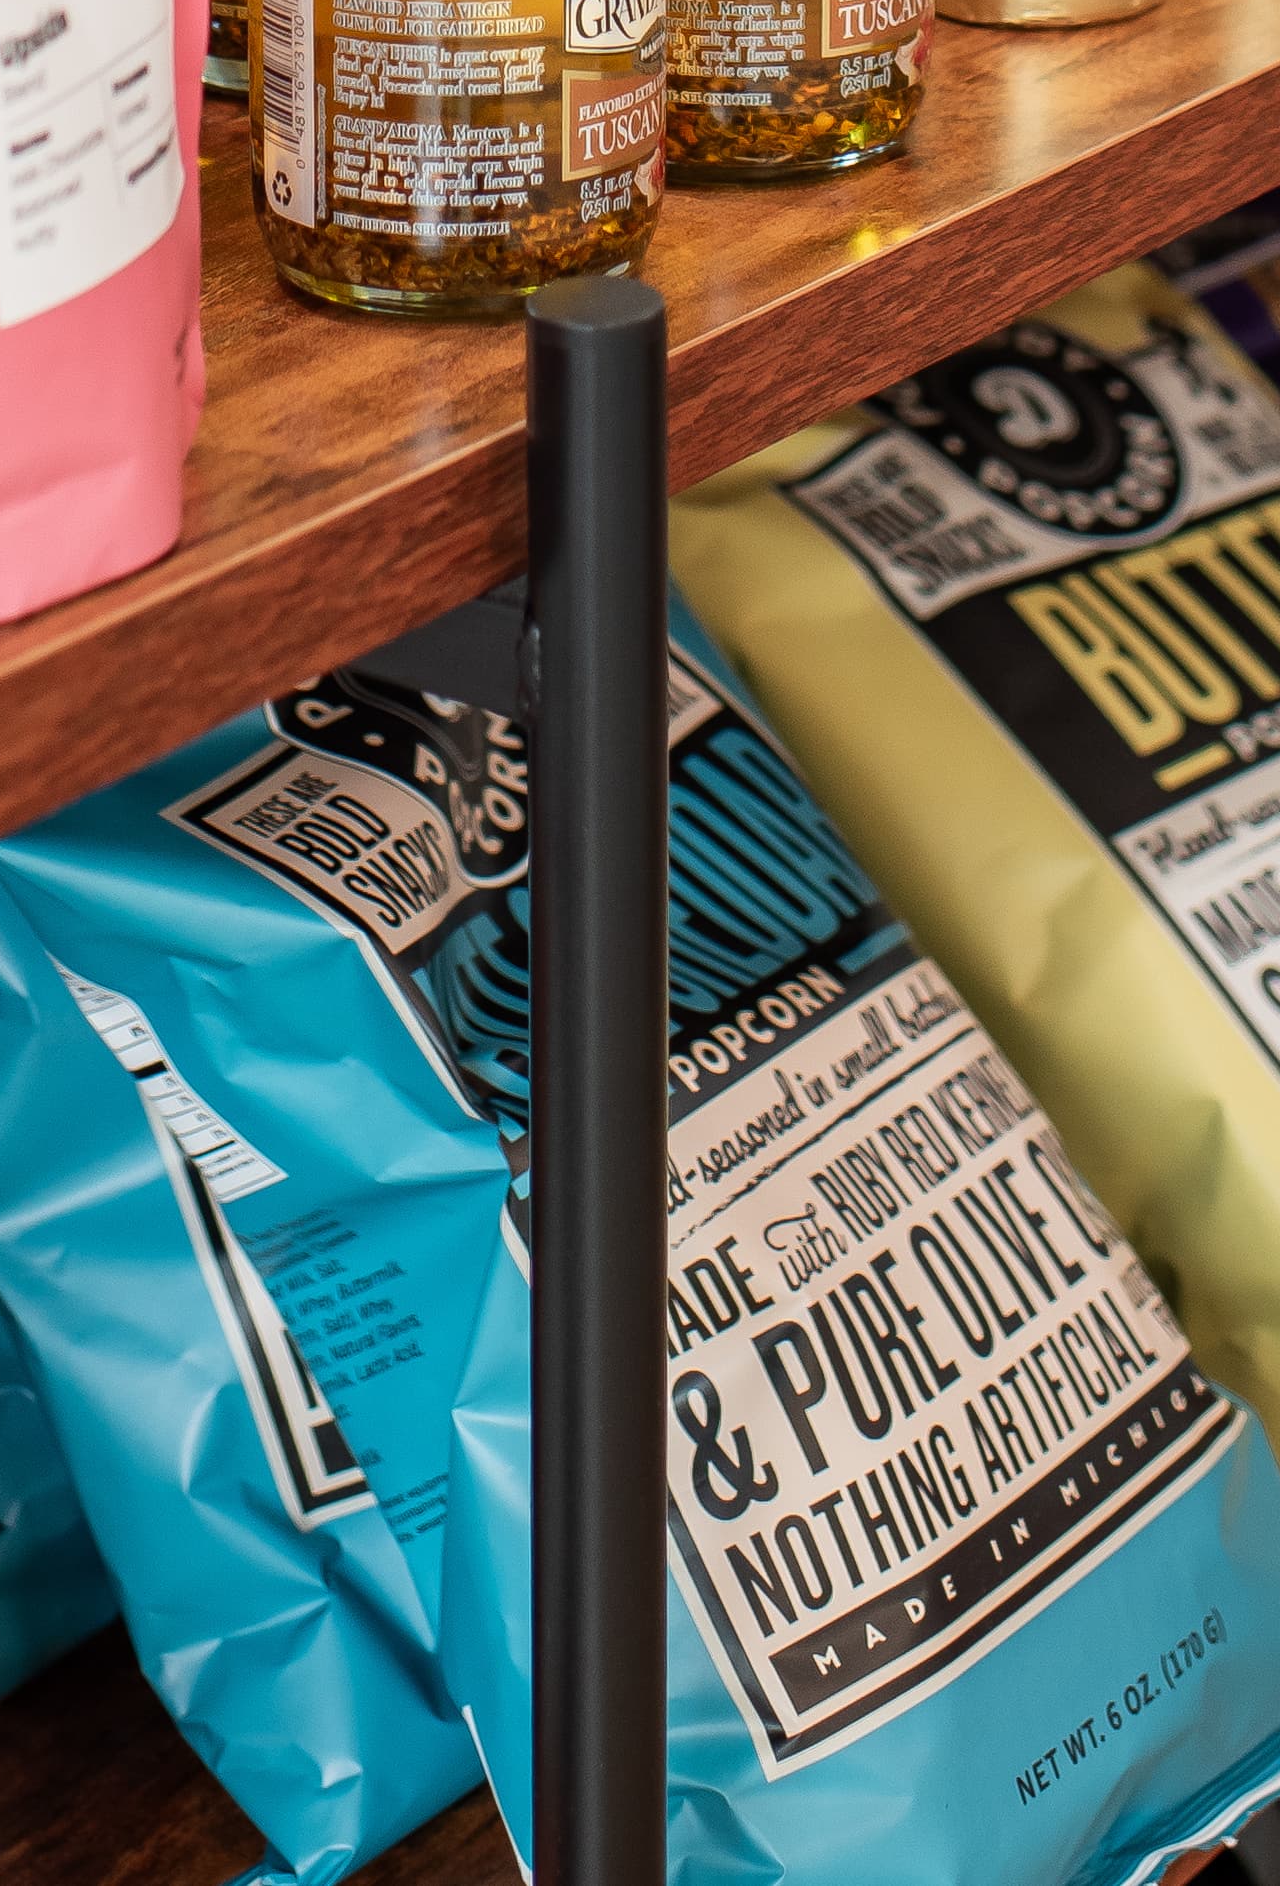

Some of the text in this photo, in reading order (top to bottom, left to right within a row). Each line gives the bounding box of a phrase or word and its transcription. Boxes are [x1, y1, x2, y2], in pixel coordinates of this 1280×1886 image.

[375, 17, 403, 35] OIL
[457, 0, 512, 18] VIRGIN
[577, 94, 661, 162] TUSCAN
[578, 91, 634, 123] FLAVORED
[234, 771, 339, 839] THESE ARE
[273, 792, 392, 877] BOLD
[669, 965, 846, 1094] POPCORN
[794, 1071, 834, 1109] in
[667, 1235, 776, 1360] ADE
[763, 1201, 849, 1292] with
[809, 1136, 913, 1242] RUBY
[875, 1104, 961, 1195] RED
[671, 1368, 781, 1522] &
[749, 1248, 962, 1476] PURE
[908, 1159, 1088, 1360] OLIVE
[723, 1424, 973, 1639] NOTHING
[961, 1288, 1158, 1494] ARTIFICIAL
[811, 1371, 1210, 1676] MADE IN MICHIGA
[1015, 1753, 1062, 1807] NET
[1063, 1717, 1107, 1768] WT.
[1106, 1701, 1123, 1731] 6
[1122, 1676, 1163, 1717] OZ.
